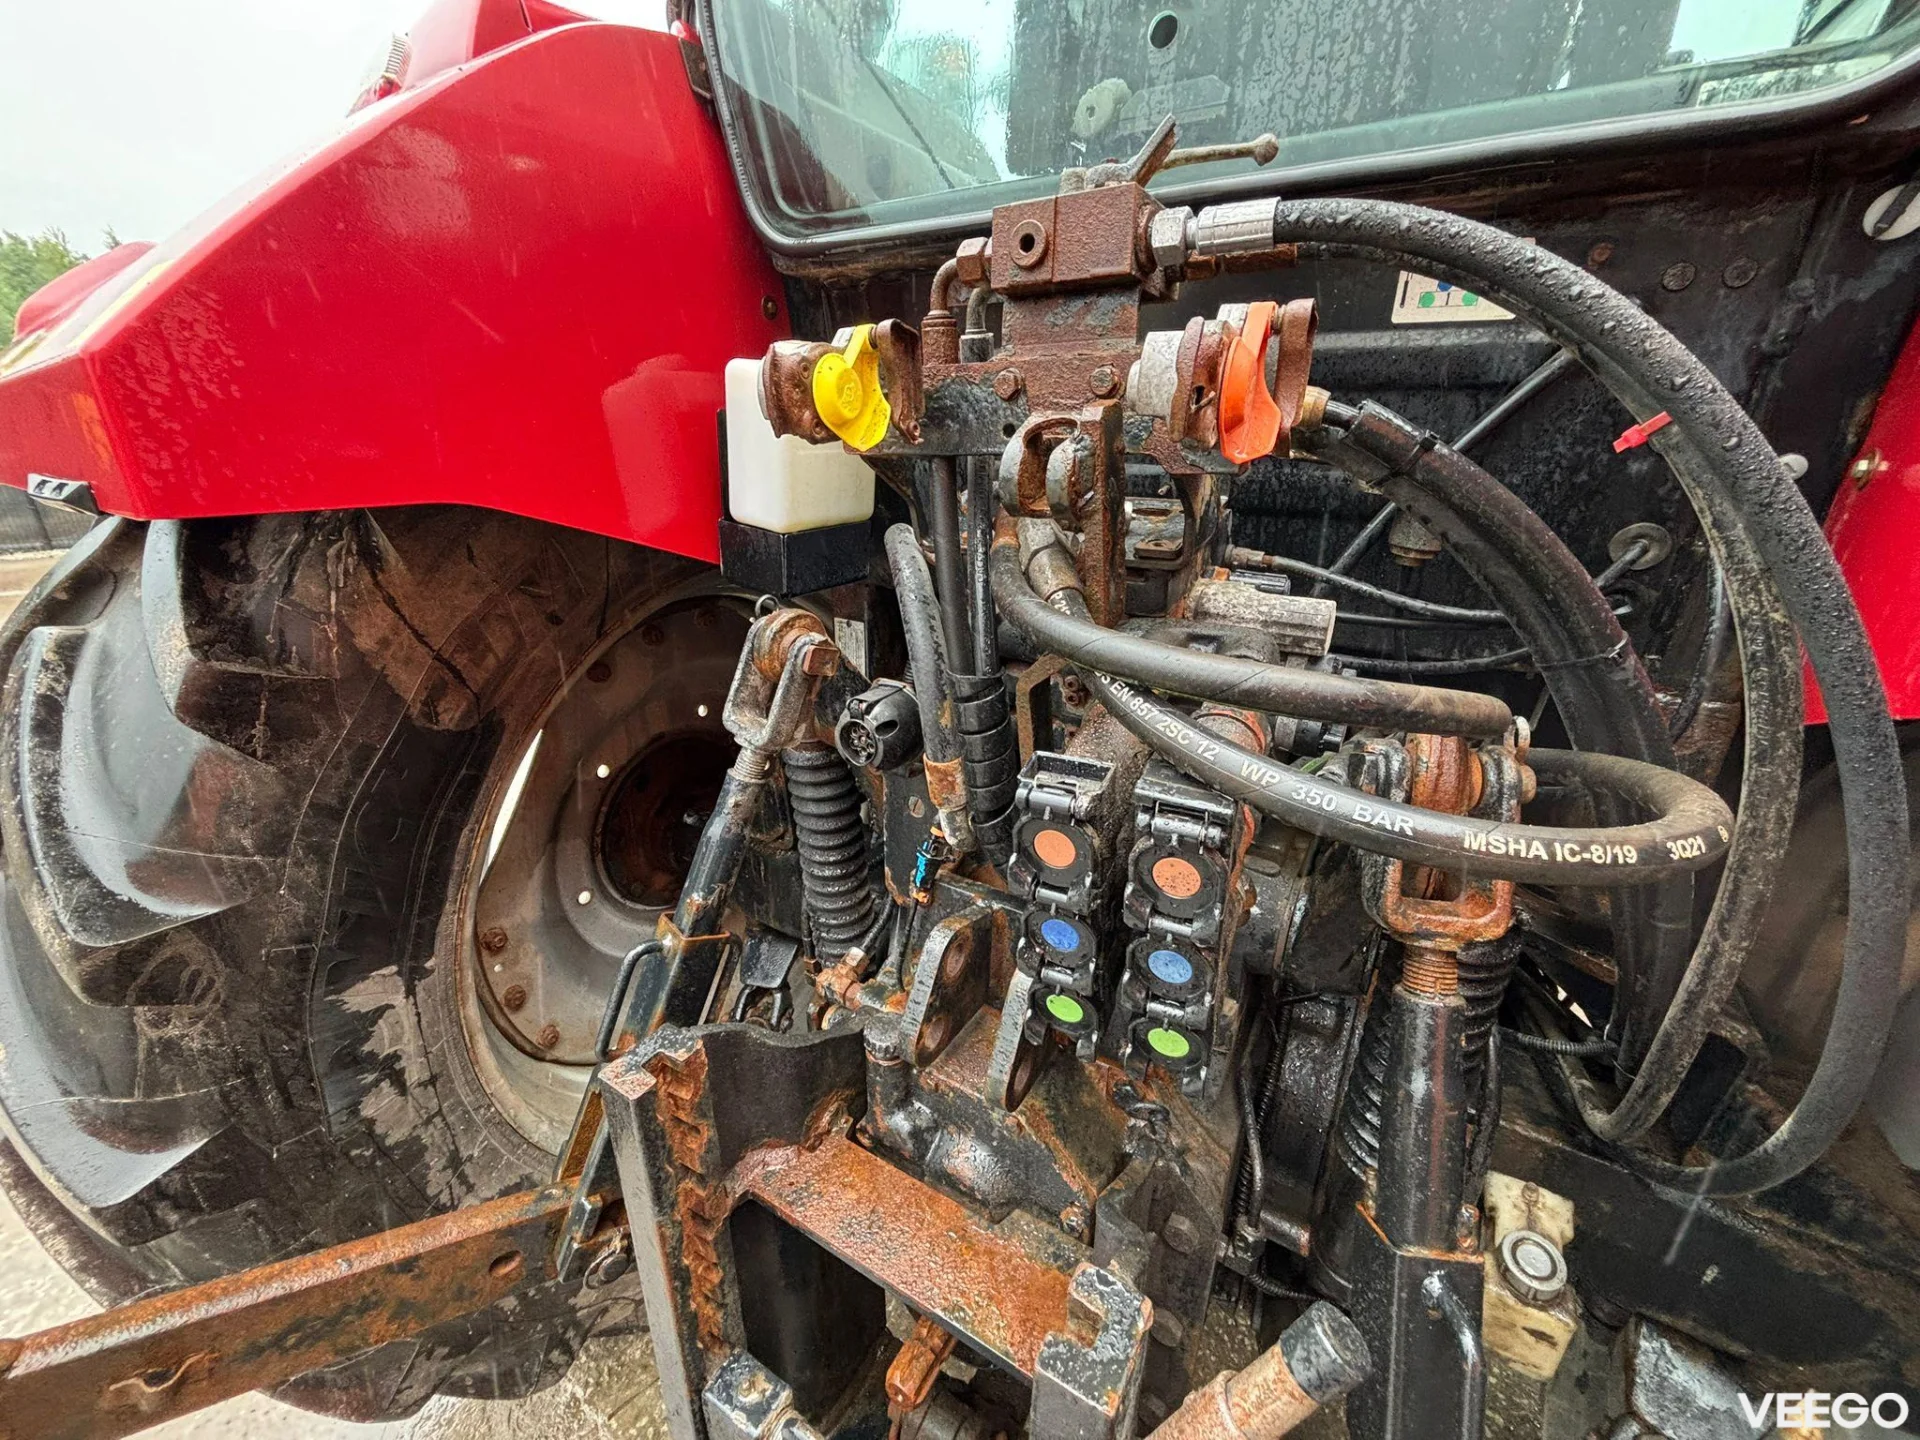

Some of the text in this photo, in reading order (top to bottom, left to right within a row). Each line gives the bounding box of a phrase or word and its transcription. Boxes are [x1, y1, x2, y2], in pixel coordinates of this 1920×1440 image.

[1109, 680, 1135, 702] EN
[1129, 696, 1160, 721] 857
[1154, 717, 1194, 745] 2SC
[1196, 740, 1221, 761] 12
[1240, 760, 1281, 789] WP
[1290, 783, 1338, 812] 350
[1352, 801, 1415, 836] BAR
[1463, 830, 1549, 861] MSHA
[1554, 841, 1639, 864] IC-8/19
[1666, 835, 1706, 861] 3Q21
